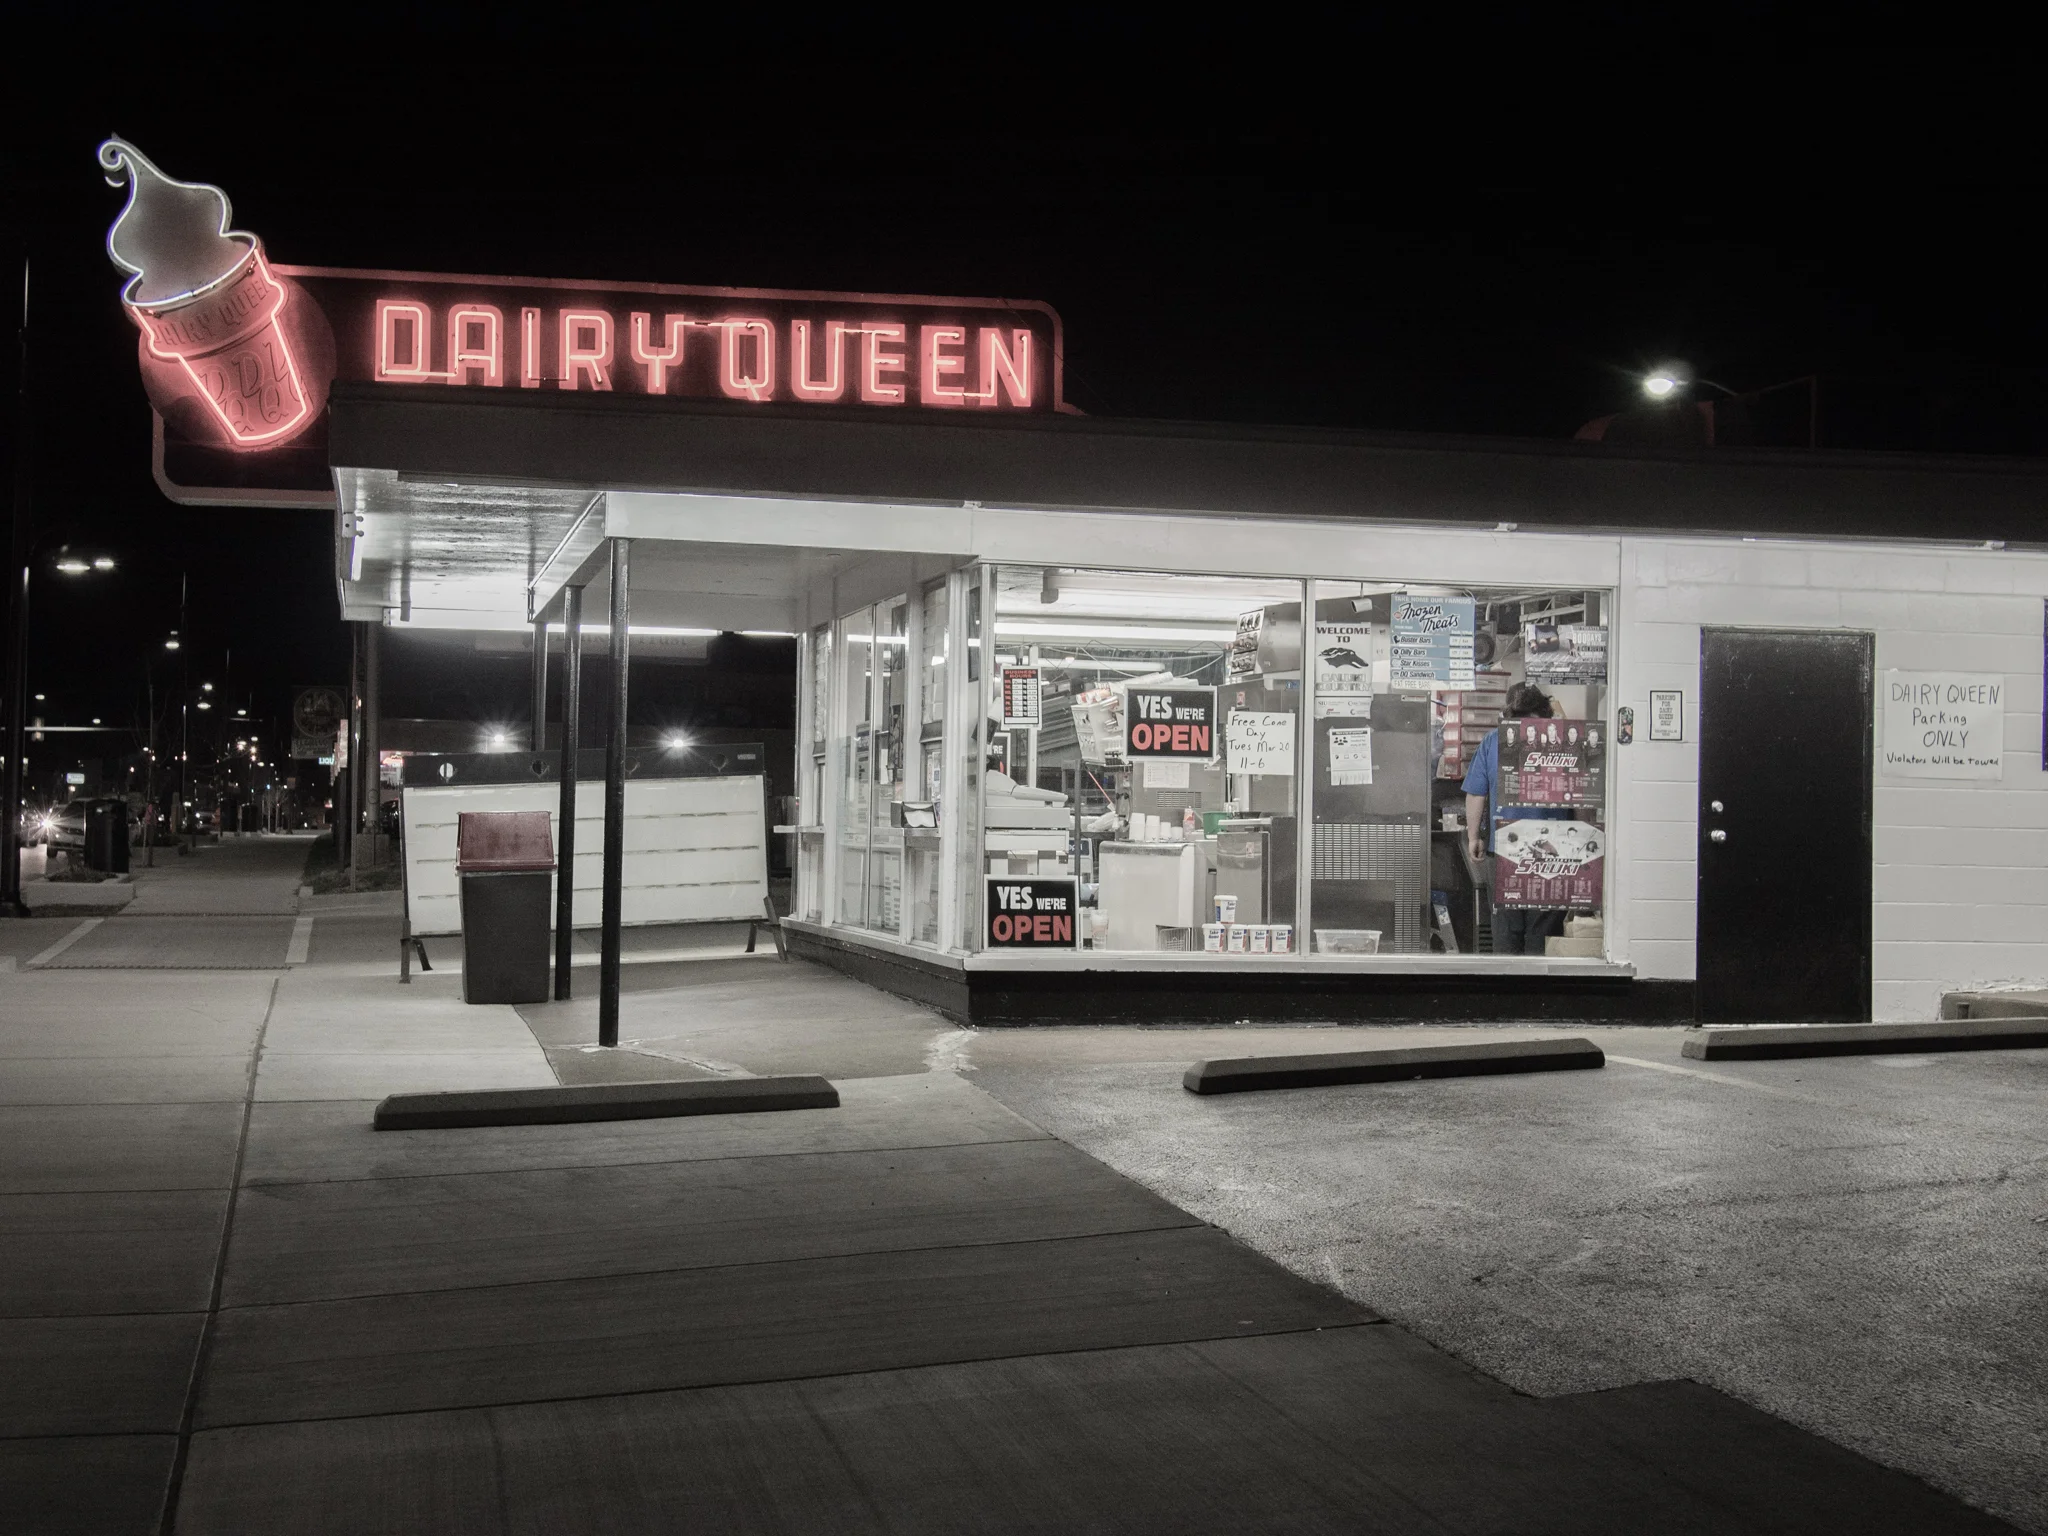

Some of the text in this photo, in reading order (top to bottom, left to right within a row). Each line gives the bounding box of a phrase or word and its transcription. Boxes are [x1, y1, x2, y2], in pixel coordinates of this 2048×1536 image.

[374, 298, 685, 395] DAIRY
[720, 315, 1033, 408] QUEEN
[1399, 602, 1443, 620] Frozen
[1316, 627, 1371, 635] WELCOME
[1419, 613, 1460, 634] Treats
[1336, 635, 1351, 643] TO
[1400, 635, 1432, 644] Buster Bars
[1413, 648, 1426, 656] Bars
[1409, 670, 1435, 678] Sandwich
[1892, 683, 2001, 706] DAIRY QUEEN
[1137, 695, 1205, 720] YES WE'RE
[1231, 714, 1288, 727] Free Cone
[1912, 707, 1968, 727] Parking
[1131, 723, 1209, 751] OPEN
[1246, 727, 1267, 741] Day
[1922, 730, 1970, 749] ONLY
[1228, 739, 1290, 753] Tues Mar 20
[1523, 751, 1578, 768] SALUKI
[1953, 757, 1965, 765] be
[1515, 857, 1581, 876] SALUKI
[996, 886, 1067, 910] YES WE'RE
[992, 914, 1072, 942] OPEN
